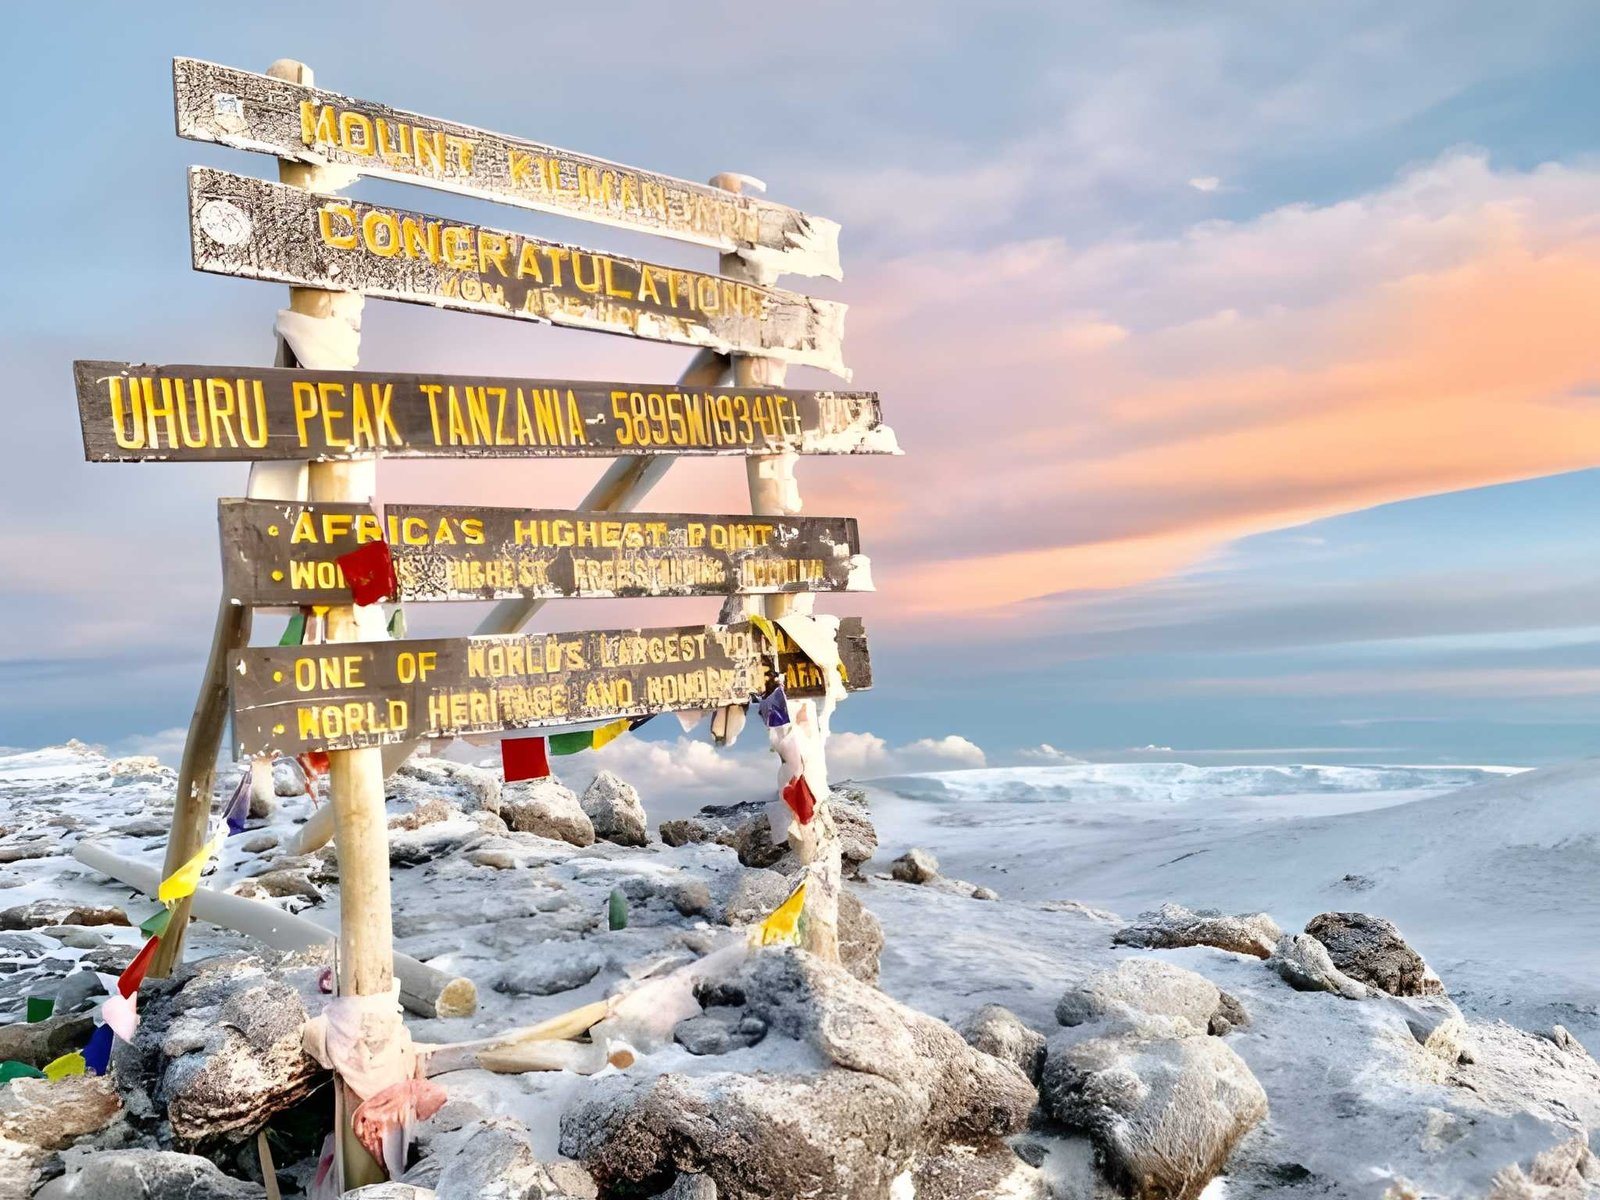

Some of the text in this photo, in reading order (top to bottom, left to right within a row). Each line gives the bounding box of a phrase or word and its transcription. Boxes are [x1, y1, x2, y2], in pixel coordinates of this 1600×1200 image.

[300, 100, 474, 176] MOUNT
[109, 376, 268, 449] UHURU
[292, 381, 402, 447] PEAK
[420, 384, 586, 447] TANZANIA
[290, 511, 773, 550] AFRICA'S HIGHEST POINT
[294, 656, 365, 692] ONE
[397, 652, 437, 684] OF
[600, 633, 706, 668] LARGEST
[297, 699, 408, 740] WORLD
[428, 683, 569, 730] HERITAGE
[585, 677, 632, 707] AND
